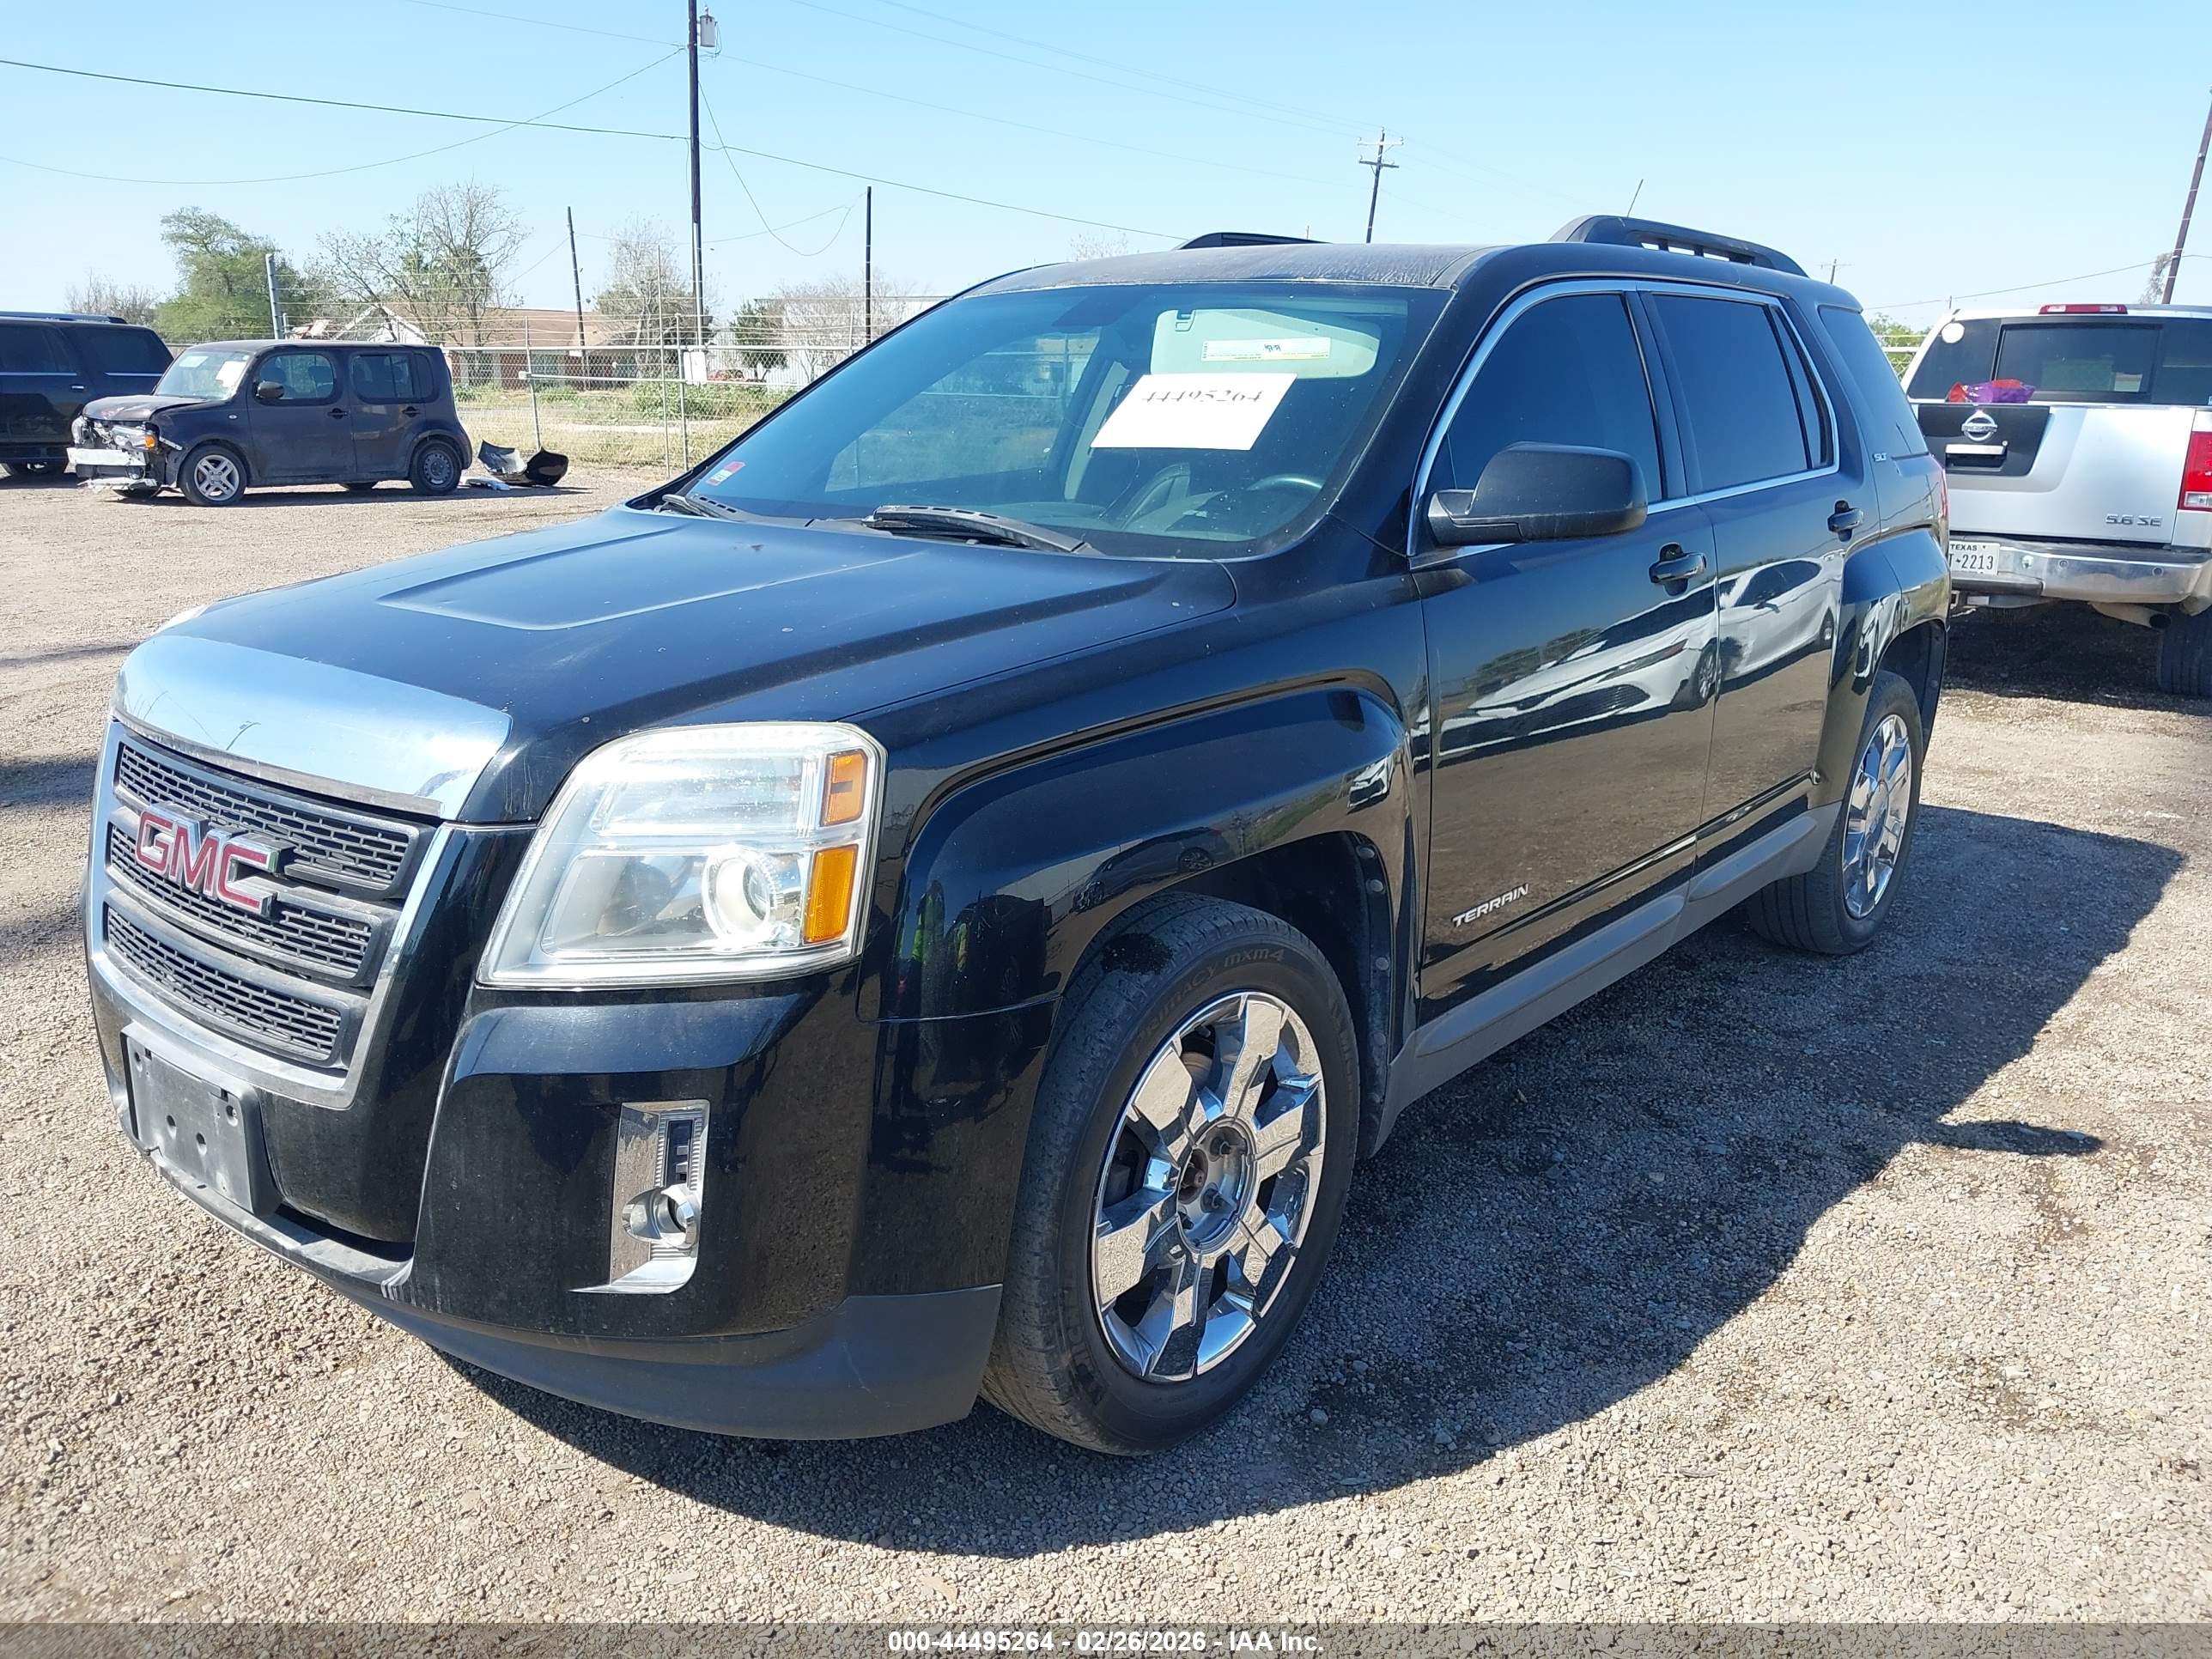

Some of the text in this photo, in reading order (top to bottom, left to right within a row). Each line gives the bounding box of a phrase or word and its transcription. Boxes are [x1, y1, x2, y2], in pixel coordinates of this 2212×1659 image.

[2136, 514, 2163, 527] SE
[136, 805, 280, 915] GMC
[1451, 883, 1529, 928] TERRAIN
